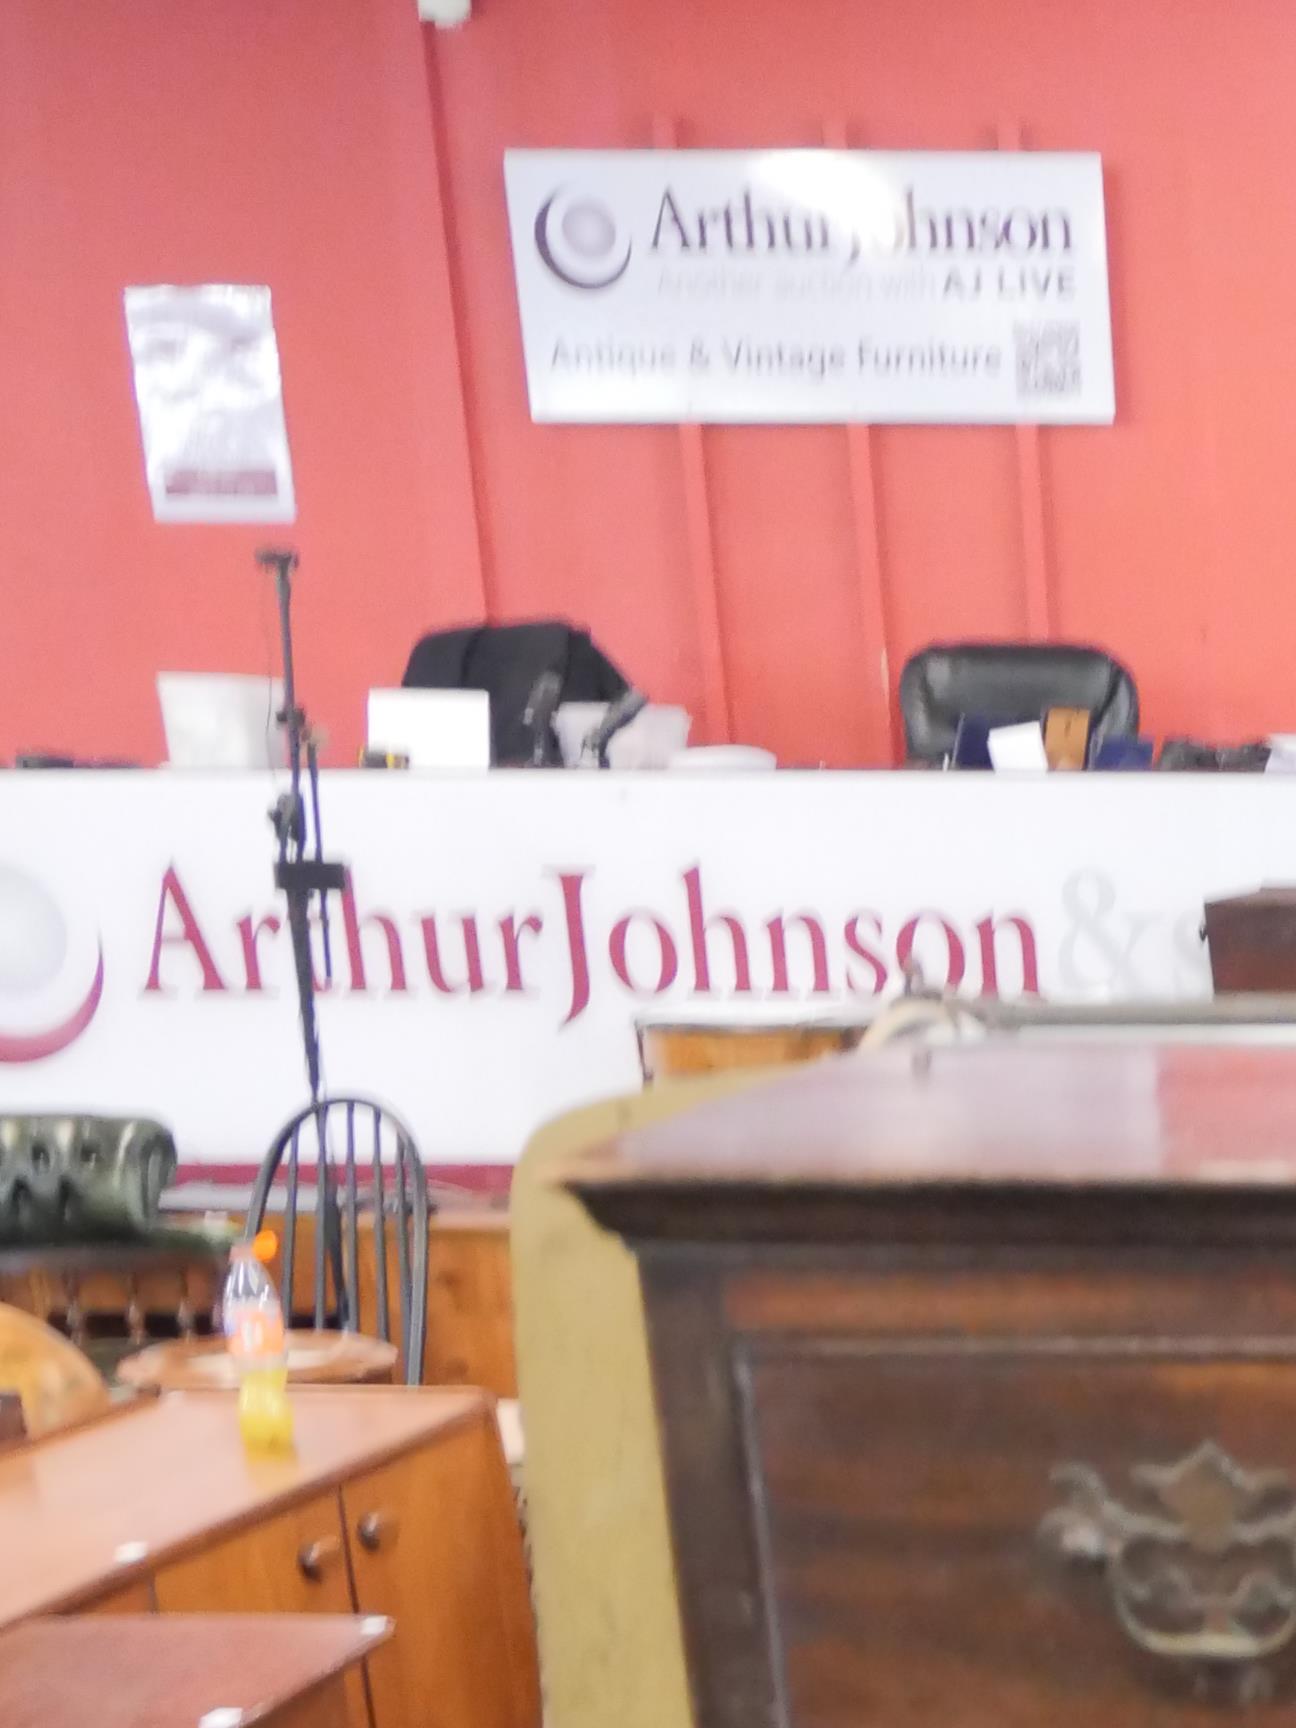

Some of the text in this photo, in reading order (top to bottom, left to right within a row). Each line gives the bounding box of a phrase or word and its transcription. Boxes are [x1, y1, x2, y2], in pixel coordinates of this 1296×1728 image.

[843, 182, 1074, 273] hnson
[997, 266, 1076, 299] LIVE
[550, 337, 1003, 380] Antique & Vintage Furniture
